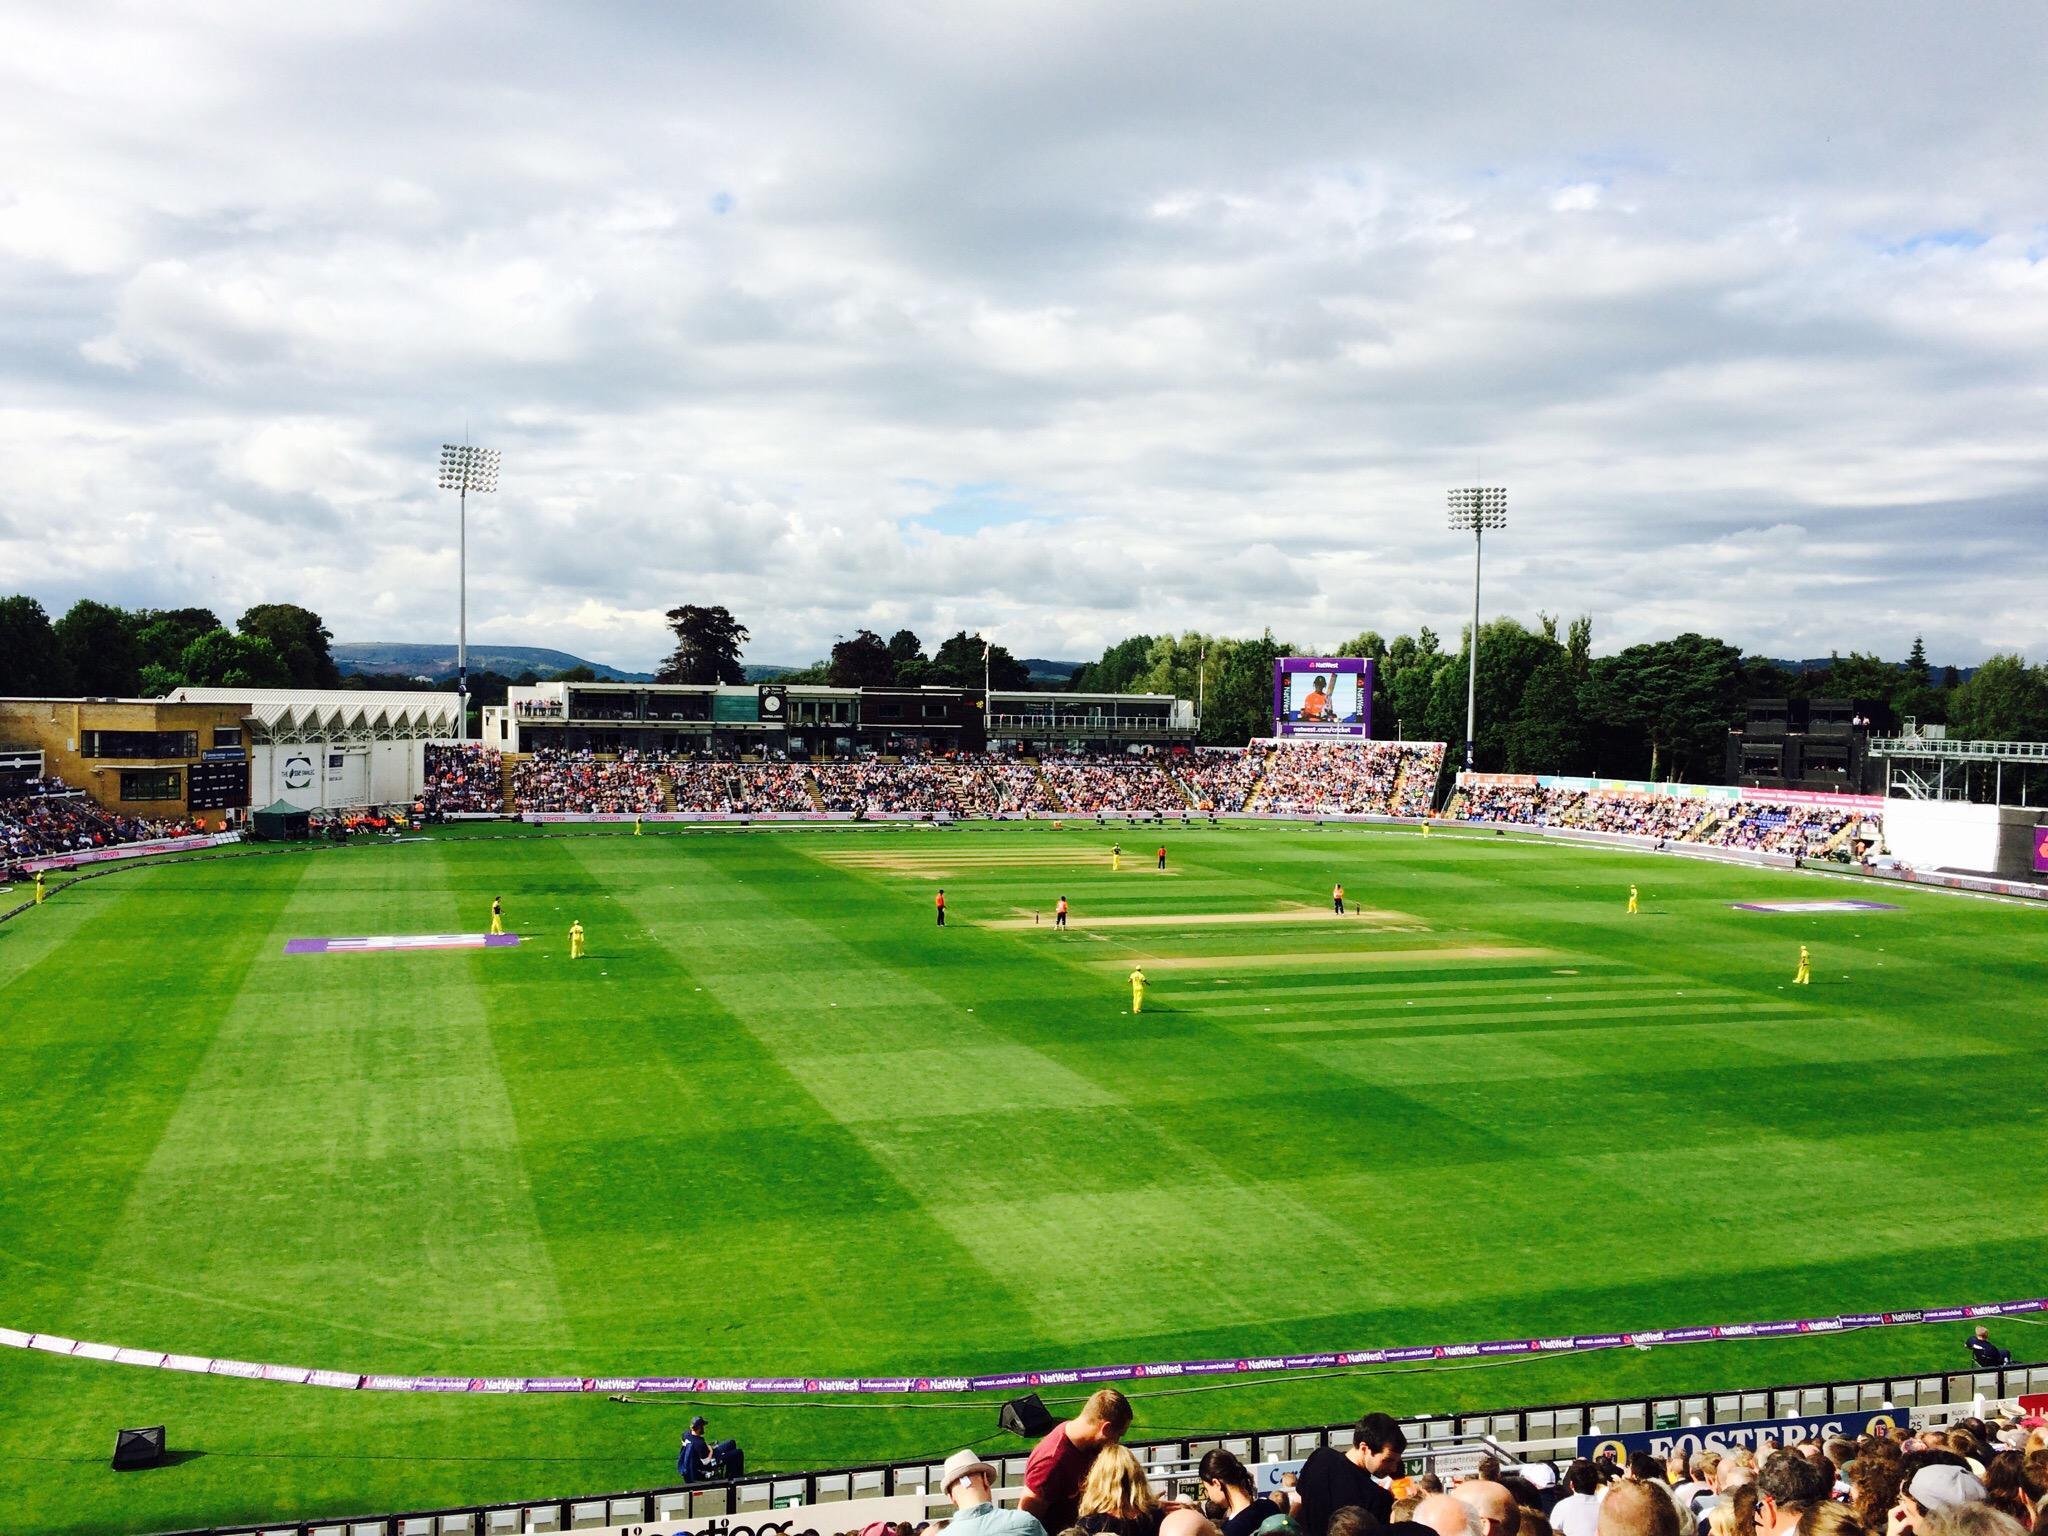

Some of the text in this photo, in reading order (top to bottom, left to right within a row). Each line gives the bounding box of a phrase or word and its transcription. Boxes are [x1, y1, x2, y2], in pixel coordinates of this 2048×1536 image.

[1356, 687, 1364, 716] NatWest
[1293, 726, 1351, 734] natwest.com/cricket
[146, 845, 166, 853] TOYOTA
[101, 851, 120, 859] TOYOTA
[1916, 875, 1945, 886] NatWest
[1961, 880, 1992, 891] NatWest
[2008, 887, 2041, 898] NatWest
[1972, 1305, 2000, 1316] NatWest
[1892, 1312, 1922, 1322] NatWest
[1719, 1326, 1752, 1336] NatWest
[1808, 1321, 1838, 1331] NatWest
[1631, 1332, 1664, 1343] NatWest
[1539, 1338, 1574, 1349] NatWest
[1443, 1345, 1479, 1356] NatWest
[1348, 1352, 1384, 1363] NatWest
[1248, 1358, 1285, 1369] NatWest
[1145, 1364, 1183, 1375] NatWest
[974, 1376, 1026, 1386] natwest.com/cricket
[1040, 1372, 1078, 1383] NatWest
[373, 1378, 412, 1389] NatWest
[485, 1379, 524, 1390] NatWest
[595, 1379, 635, 1390] NatWest
[707, 1380, 747, 1391] NatWest
[819, 1380, 859, 1391] NatWest
[930, 1379, 969, 1390] NatWest
[1911, 1421, 1923, 1431] 25
[1650, 1421, 1843, 1460] FOSTER'S
